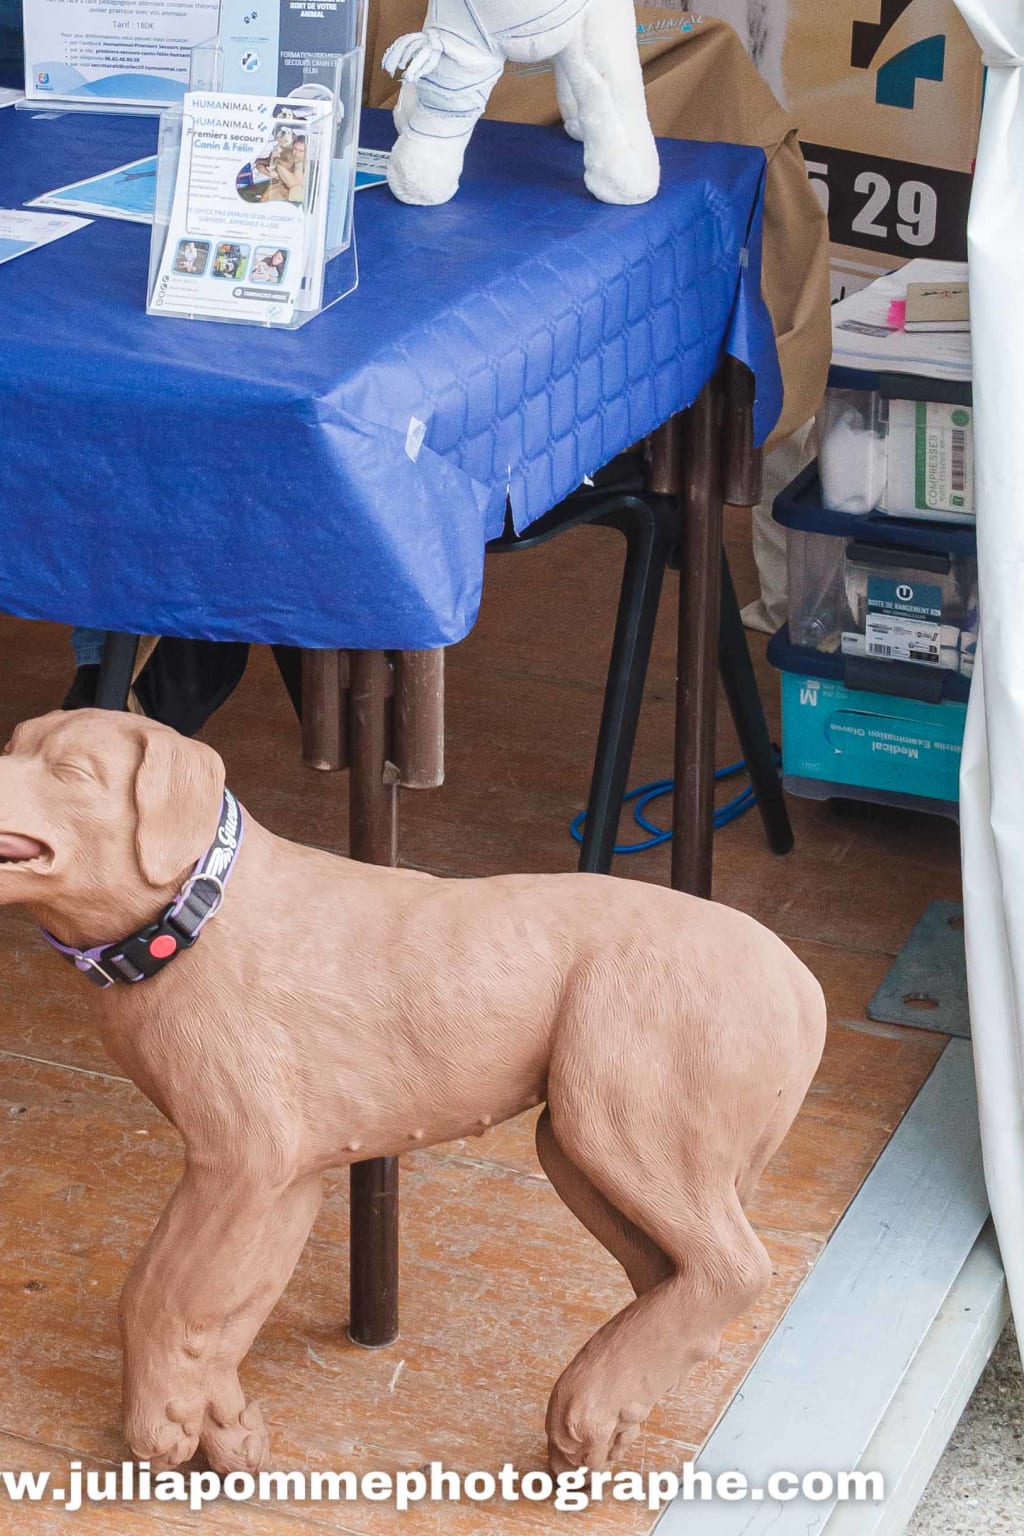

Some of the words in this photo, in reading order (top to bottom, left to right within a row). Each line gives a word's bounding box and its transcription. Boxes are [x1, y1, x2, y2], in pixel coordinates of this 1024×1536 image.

[192, 99, 254, 112] HUMANIMAL
[193, 118, 254, 130] HUMANIMAL
[186, 128, 227, 140] Premiers
[230, 132, 264, 143] secours
[194, 139, 220, 150] Canin
[851, 171, 938, 246] 29
[929, 434, 938, 506] COMPRESSES
[800, 688, 817, 707] M
[830, 723, 865, 736] Gloves
[868, 730, 931, 749] Examination
[872, 741, 919, 759] Medical
